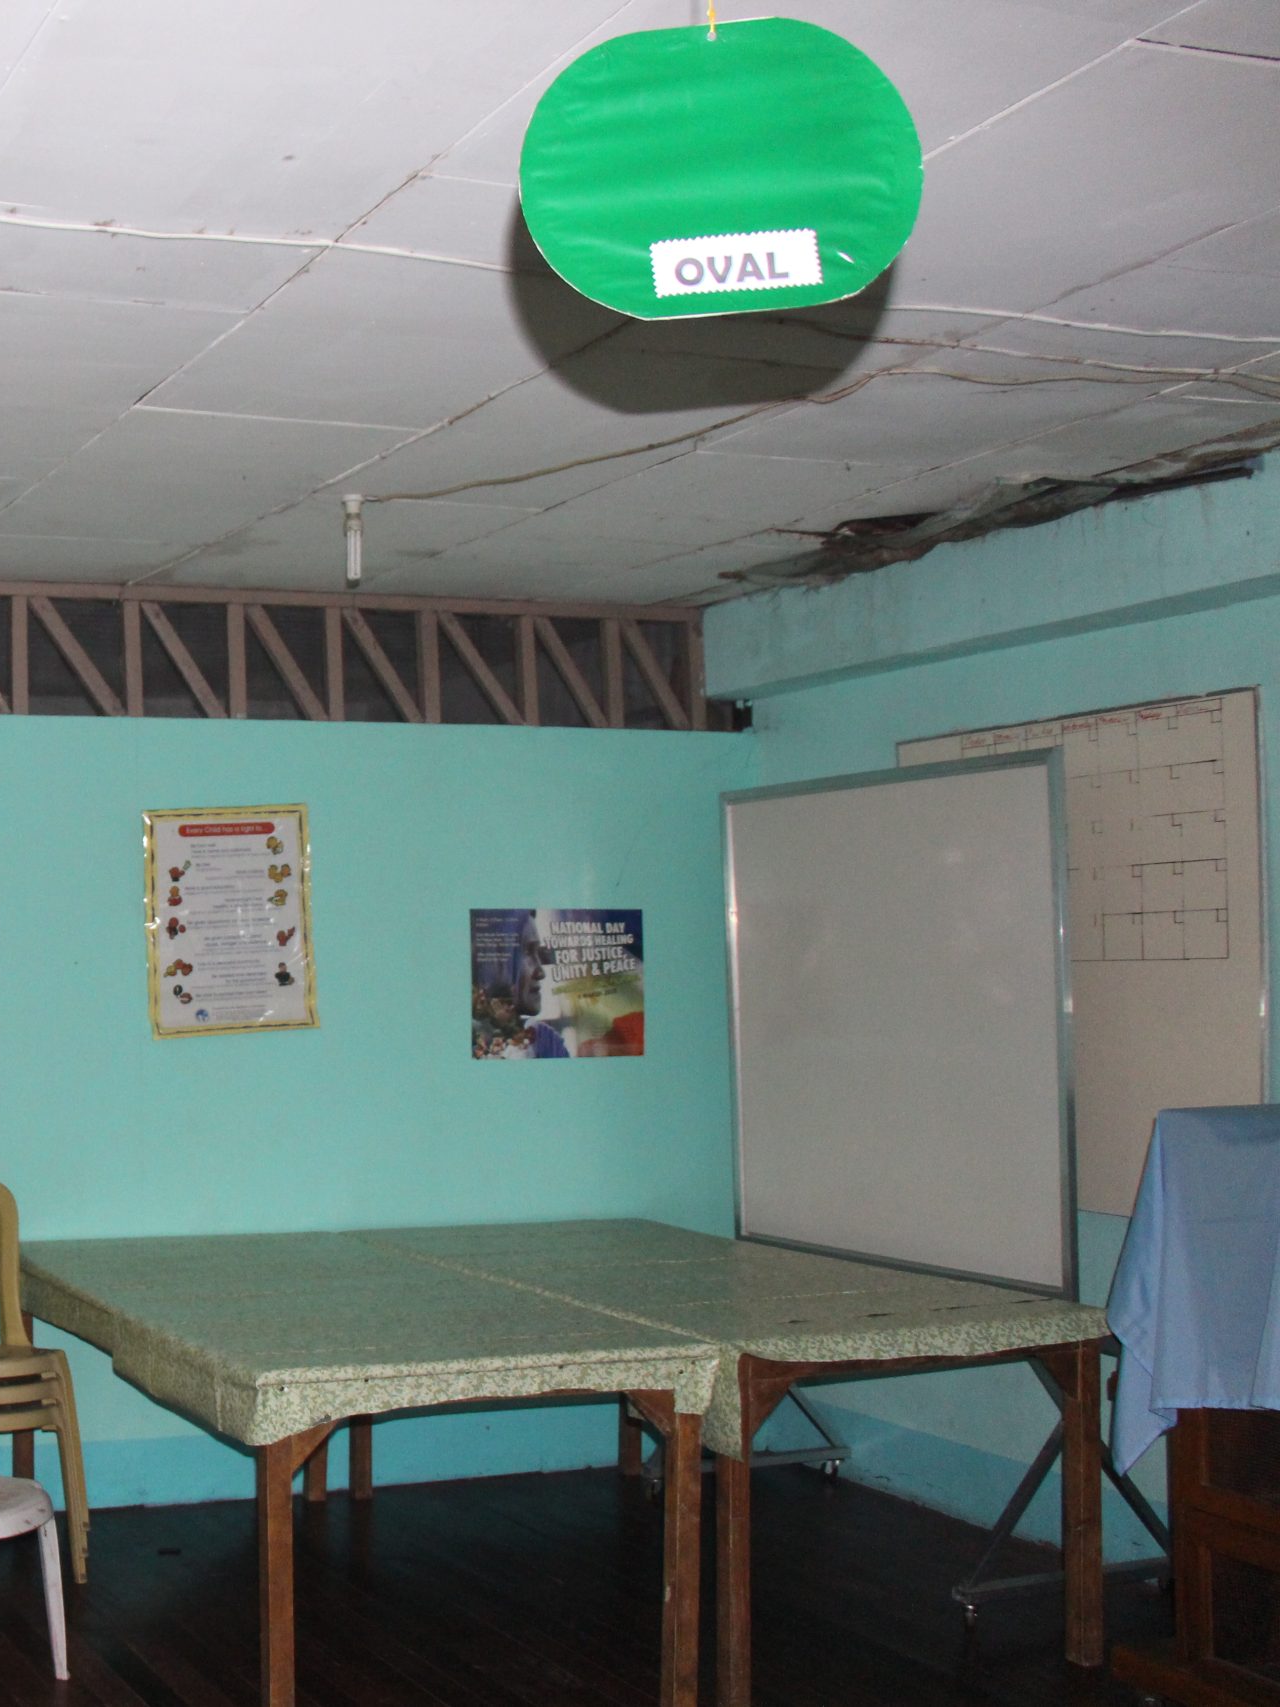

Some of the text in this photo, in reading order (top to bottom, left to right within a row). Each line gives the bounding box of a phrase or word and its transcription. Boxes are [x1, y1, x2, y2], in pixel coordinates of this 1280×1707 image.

[675, 252, 790, 286] OVAL
[551, 921, 625, 934] NATIONAL DAY
[594, 934, 634, 945] HEALING
[555, 949, 578, 964] FOR
[552, 963, 587, 982] UNITY
[592, 962, 600, 976] &
[603, 958, 636, 974] PEACE
